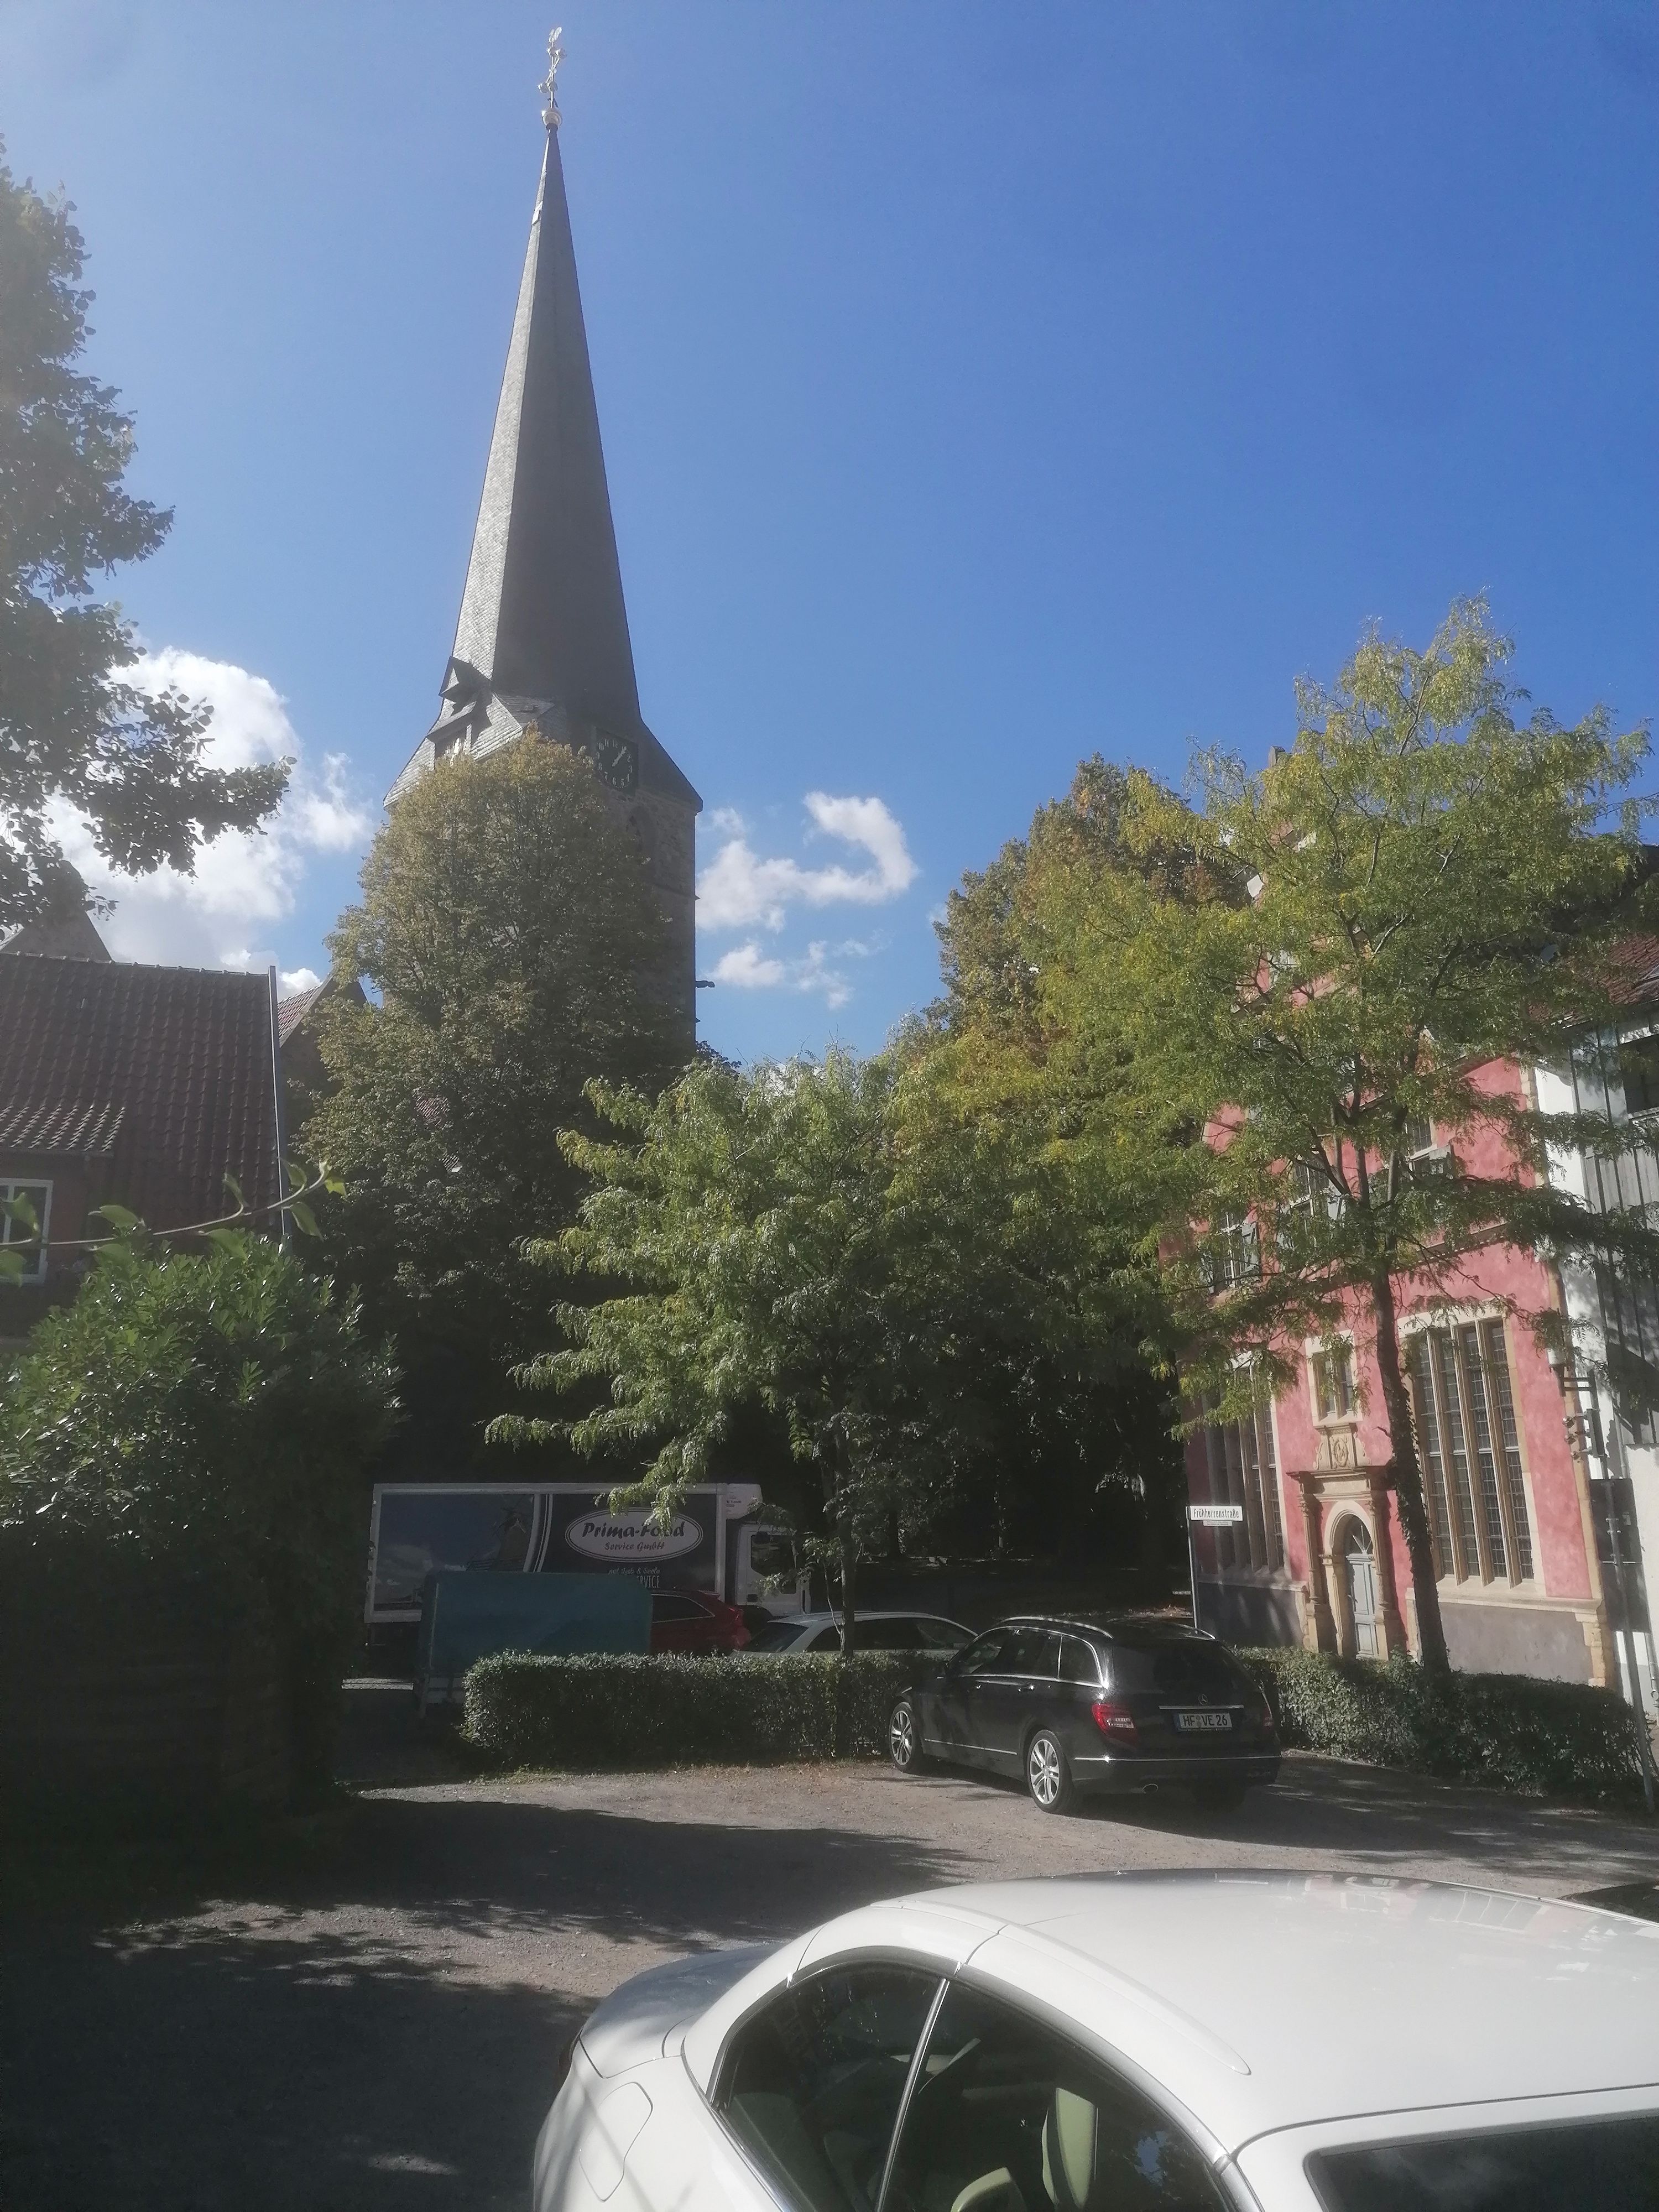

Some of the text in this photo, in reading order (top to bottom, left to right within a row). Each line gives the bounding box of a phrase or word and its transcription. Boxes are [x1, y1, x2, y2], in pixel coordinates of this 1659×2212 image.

[1193, 1509, 1239, 1519] Frühherrenstraße
[582, 1522, 685, 1539] Prima-Food
[605, 1541, 665, 1552] Service GmbH
[1183, 1715, 1228, 1726] HF VE 26
